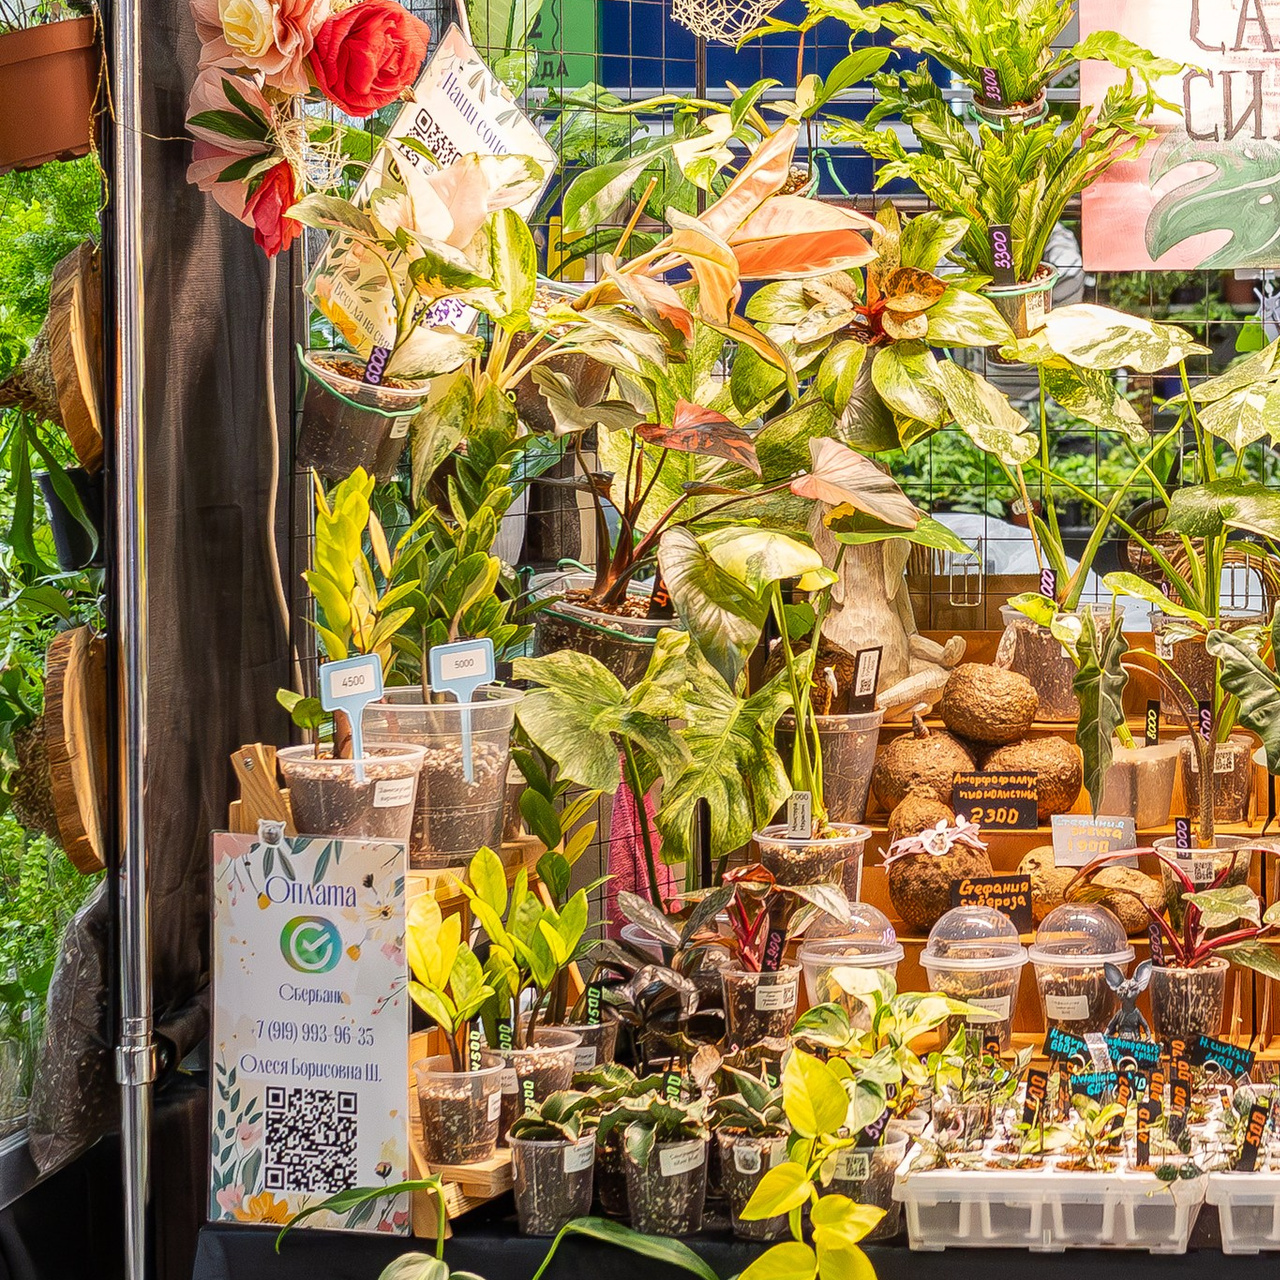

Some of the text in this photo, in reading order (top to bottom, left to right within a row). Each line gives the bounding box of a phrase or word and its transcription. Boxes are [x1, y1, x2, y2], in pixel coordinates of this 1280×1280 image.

[993, 230, 1011, 269] 3300
[454, 657, 475, 669] 5000
[341, 674, 365, 688] 4500
[1147, 708, 1158, 740] 8000
[970, 807, 1019, 825] 2300
[265, 875, 358, 908] Оплата
[279, 983, 345, 1006] Сбербанк
[268, 1020, 298, 1045] (919)
[240, 1053, 289, 1076] Олеся
[291, 1057, 362, 1081] Борисовна
[1246, 1111, 1267, 1147] 500
